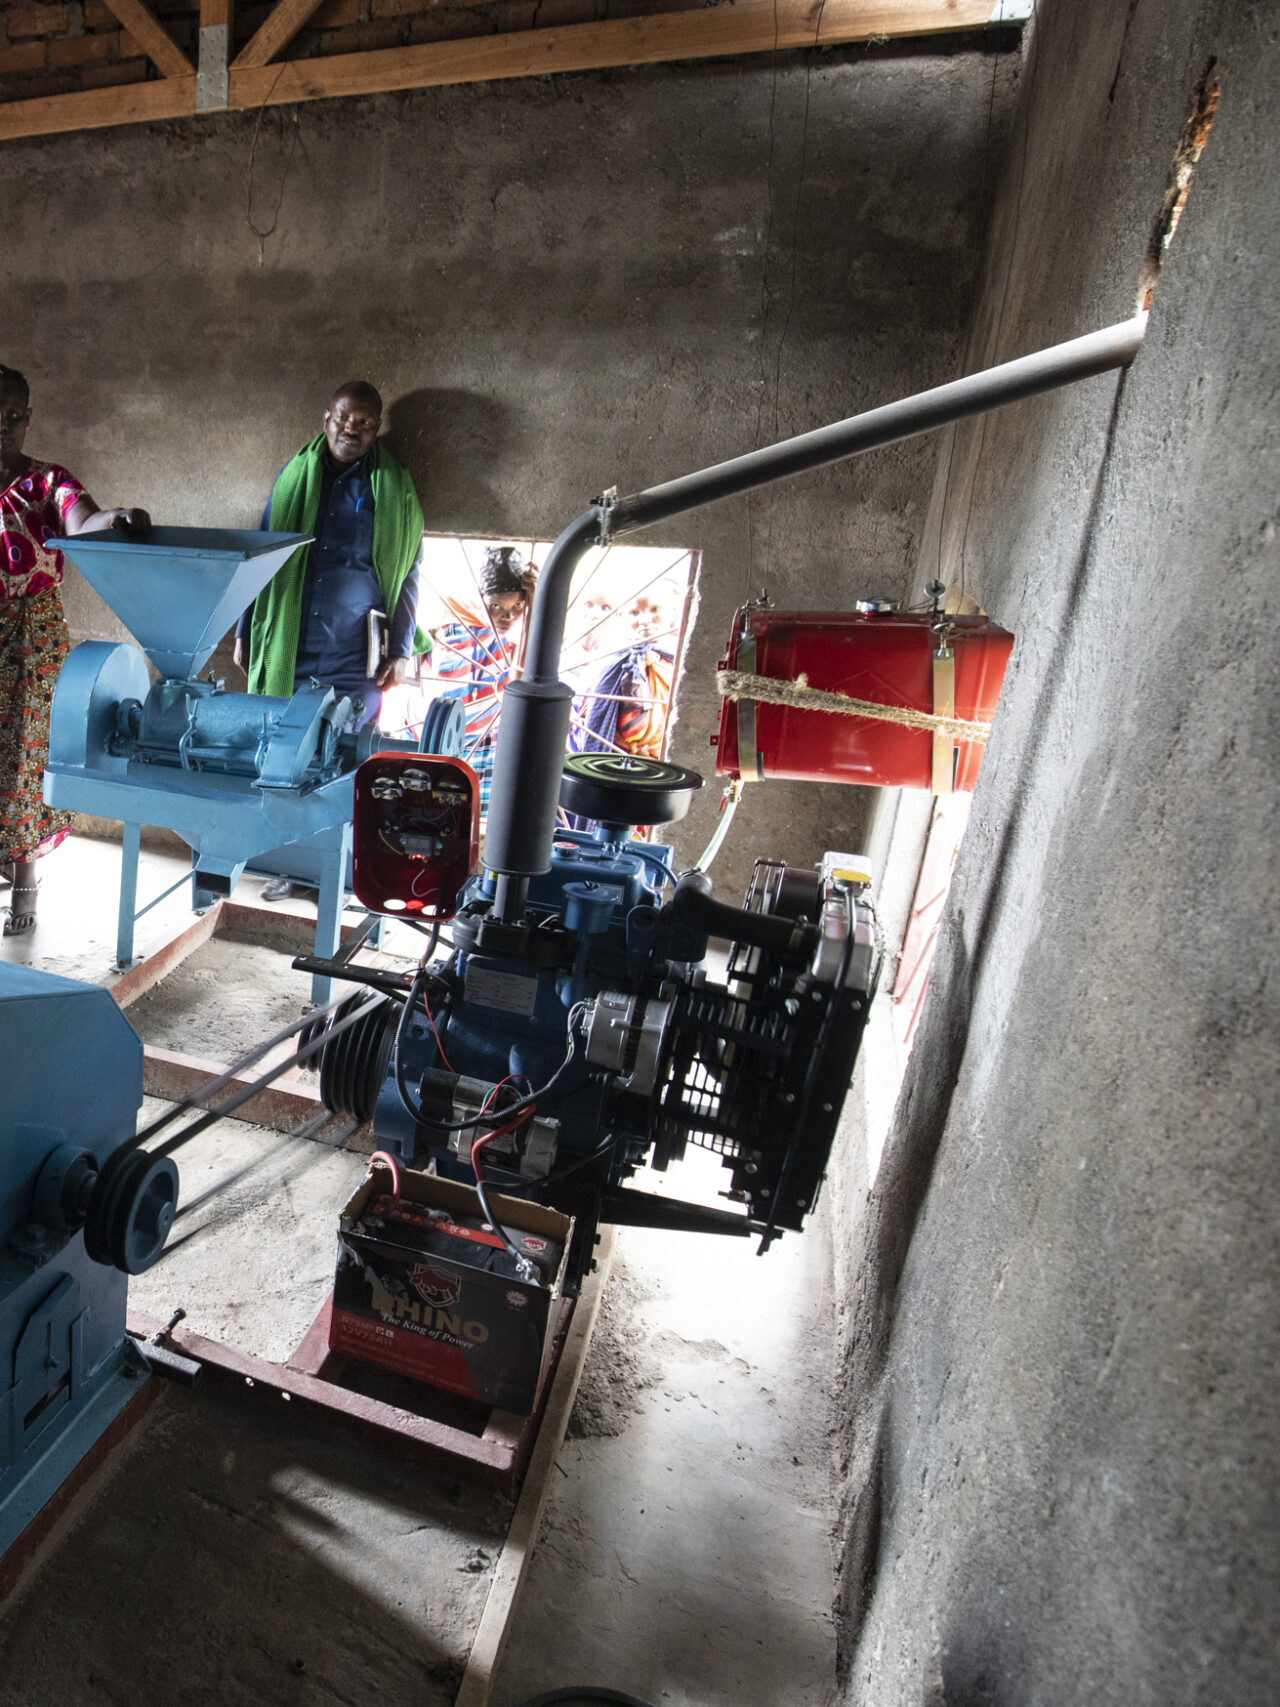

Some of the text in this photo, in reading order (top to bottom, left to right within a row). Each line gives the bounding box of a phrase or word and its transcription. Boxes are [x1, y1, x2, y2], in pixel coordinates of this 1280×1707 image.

[382, 1312, 401, 1327] The
[402, 1318, 427, 1336] King
[428, 1328, 441, 1341] of
[442, 1333, 475, 1350] Power
